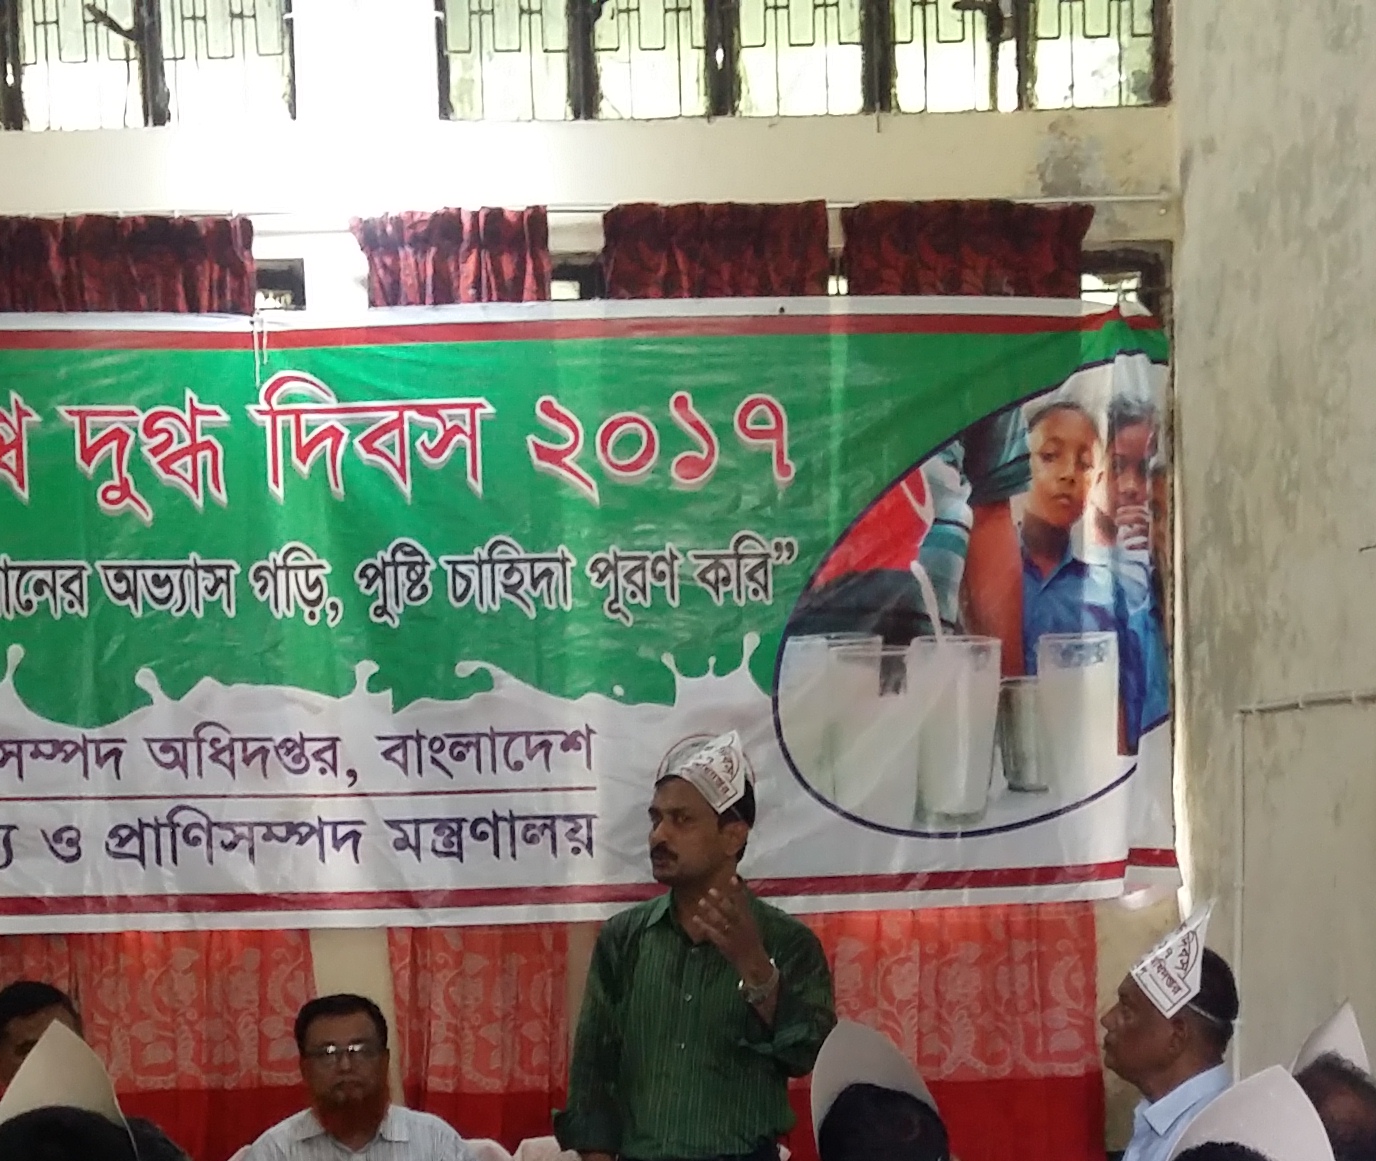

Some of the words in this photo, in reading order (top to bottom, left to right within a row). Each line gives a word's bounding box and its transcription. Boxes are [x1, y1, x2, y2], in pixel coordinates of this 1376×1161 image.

[61, 390, 228, 522] দুগ্ধ
[252, 372, 492, 502] দিবস
[529, 392, 795, 504] ২০১৭
[98, 553, 235, 617] অভ্যাস
[251, 541, 341, 627] গড়ি,
[359, 536, 434, 627] পুষ্টি
[444, 536, 572, 617] চাহিদা
[590, 544, 679, 625] পূরণ
[145, 720, 358, 788] অধিদপ্তর,
[376, 722, 595, 778] বাংলাদেশ
[41, 824, 81, 864] ও
[105, 804, 366, 869] প্রাণিসম্পদ
[384, 809, 597, 865] মন্ত্রণালয়
